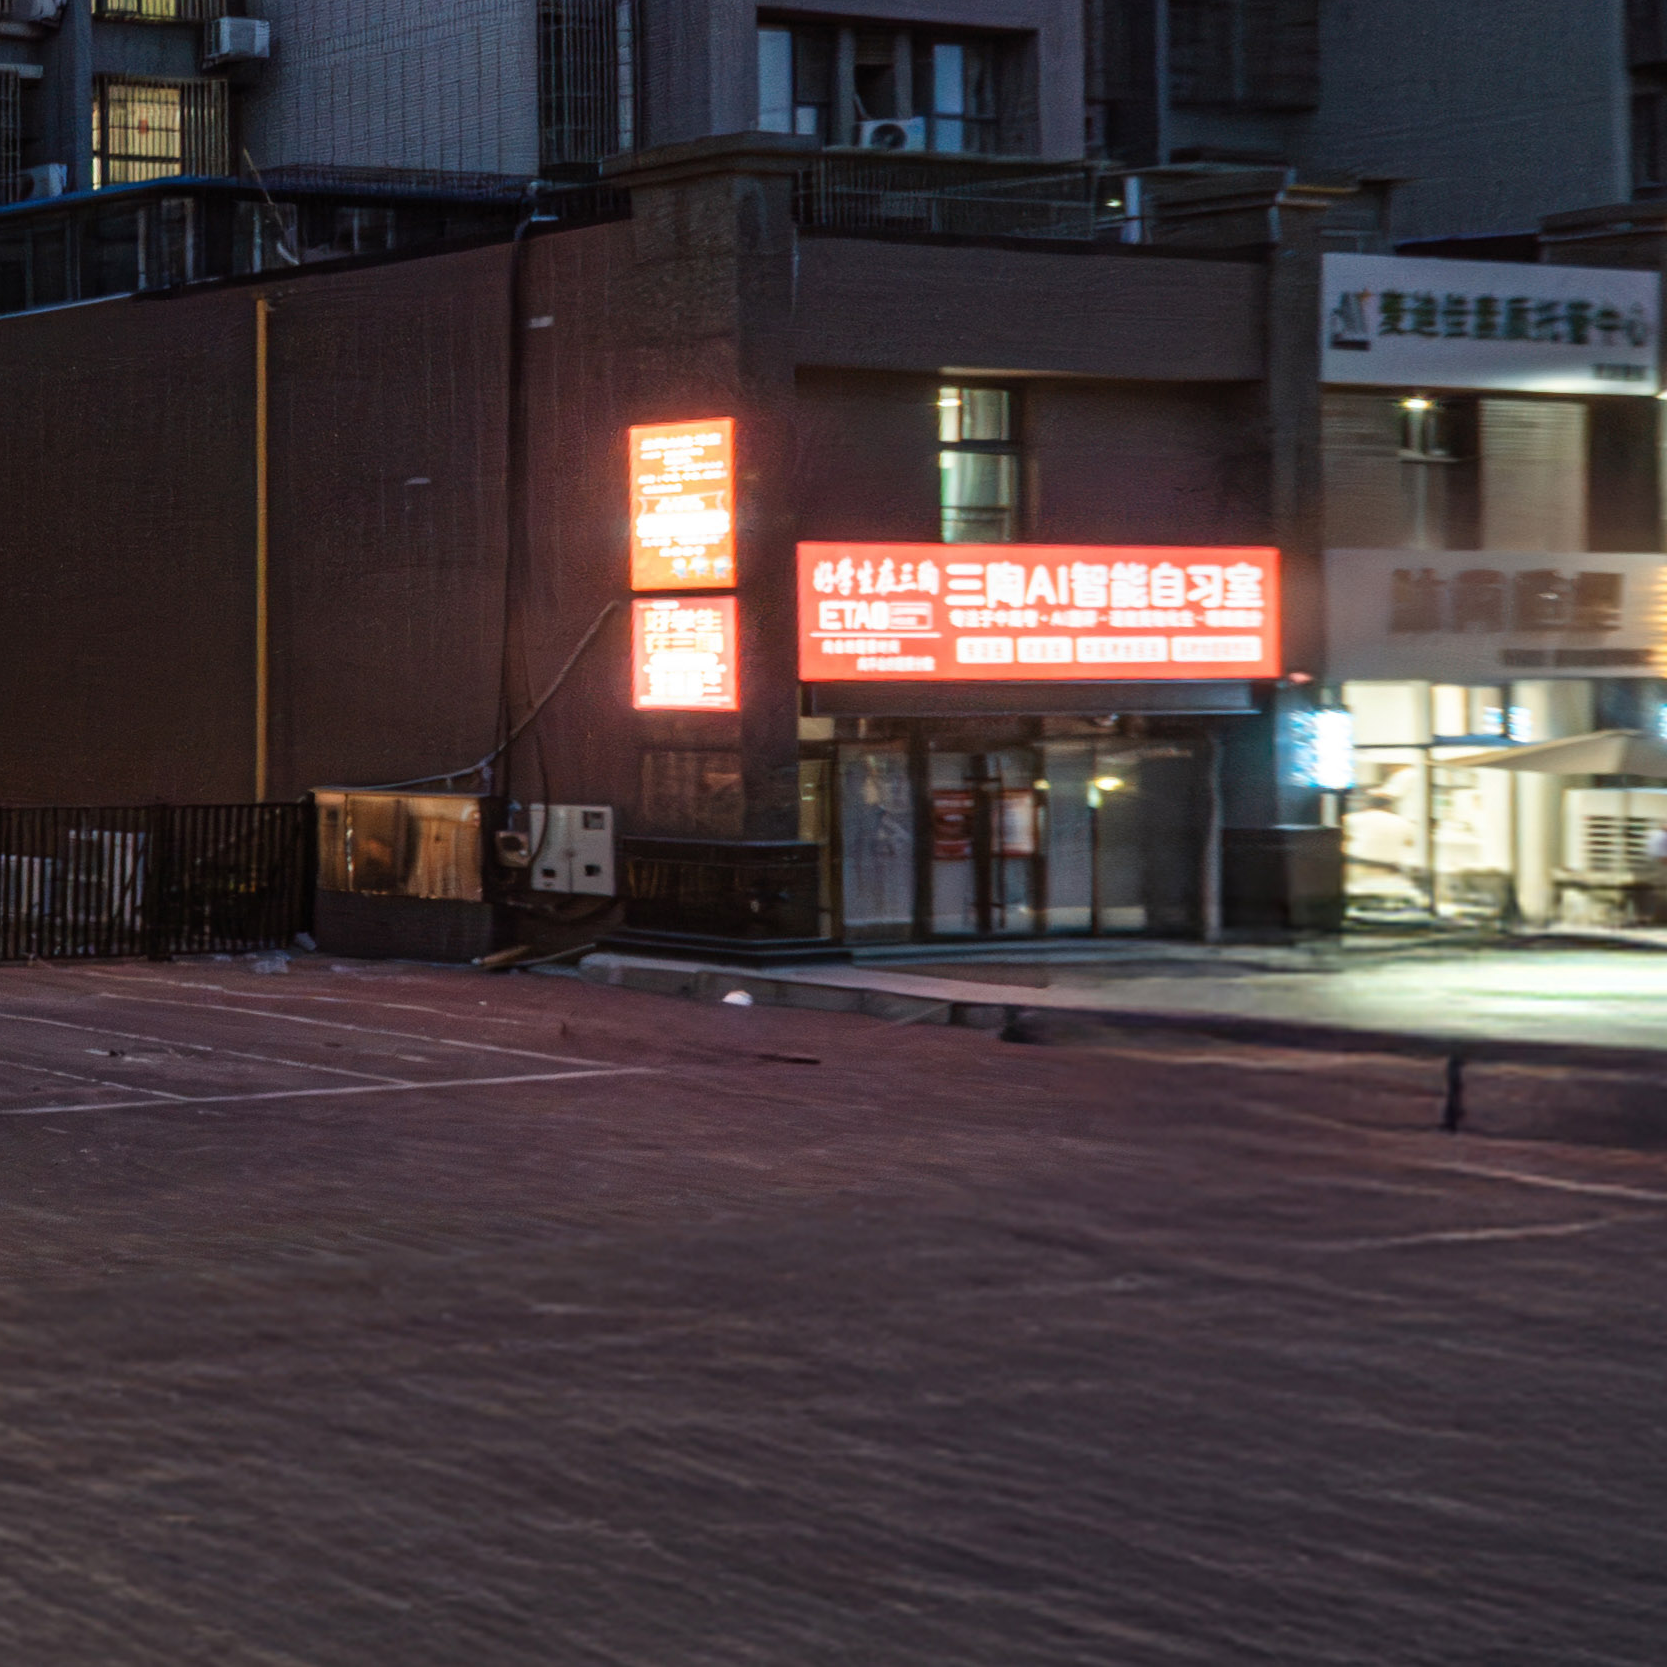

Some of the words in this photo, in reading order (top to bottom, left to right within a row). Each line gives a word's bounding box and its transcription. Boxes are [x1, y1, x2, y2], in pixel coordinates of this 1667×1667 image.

[945, 562, 1263, 608] 三陶AI智能自习室
